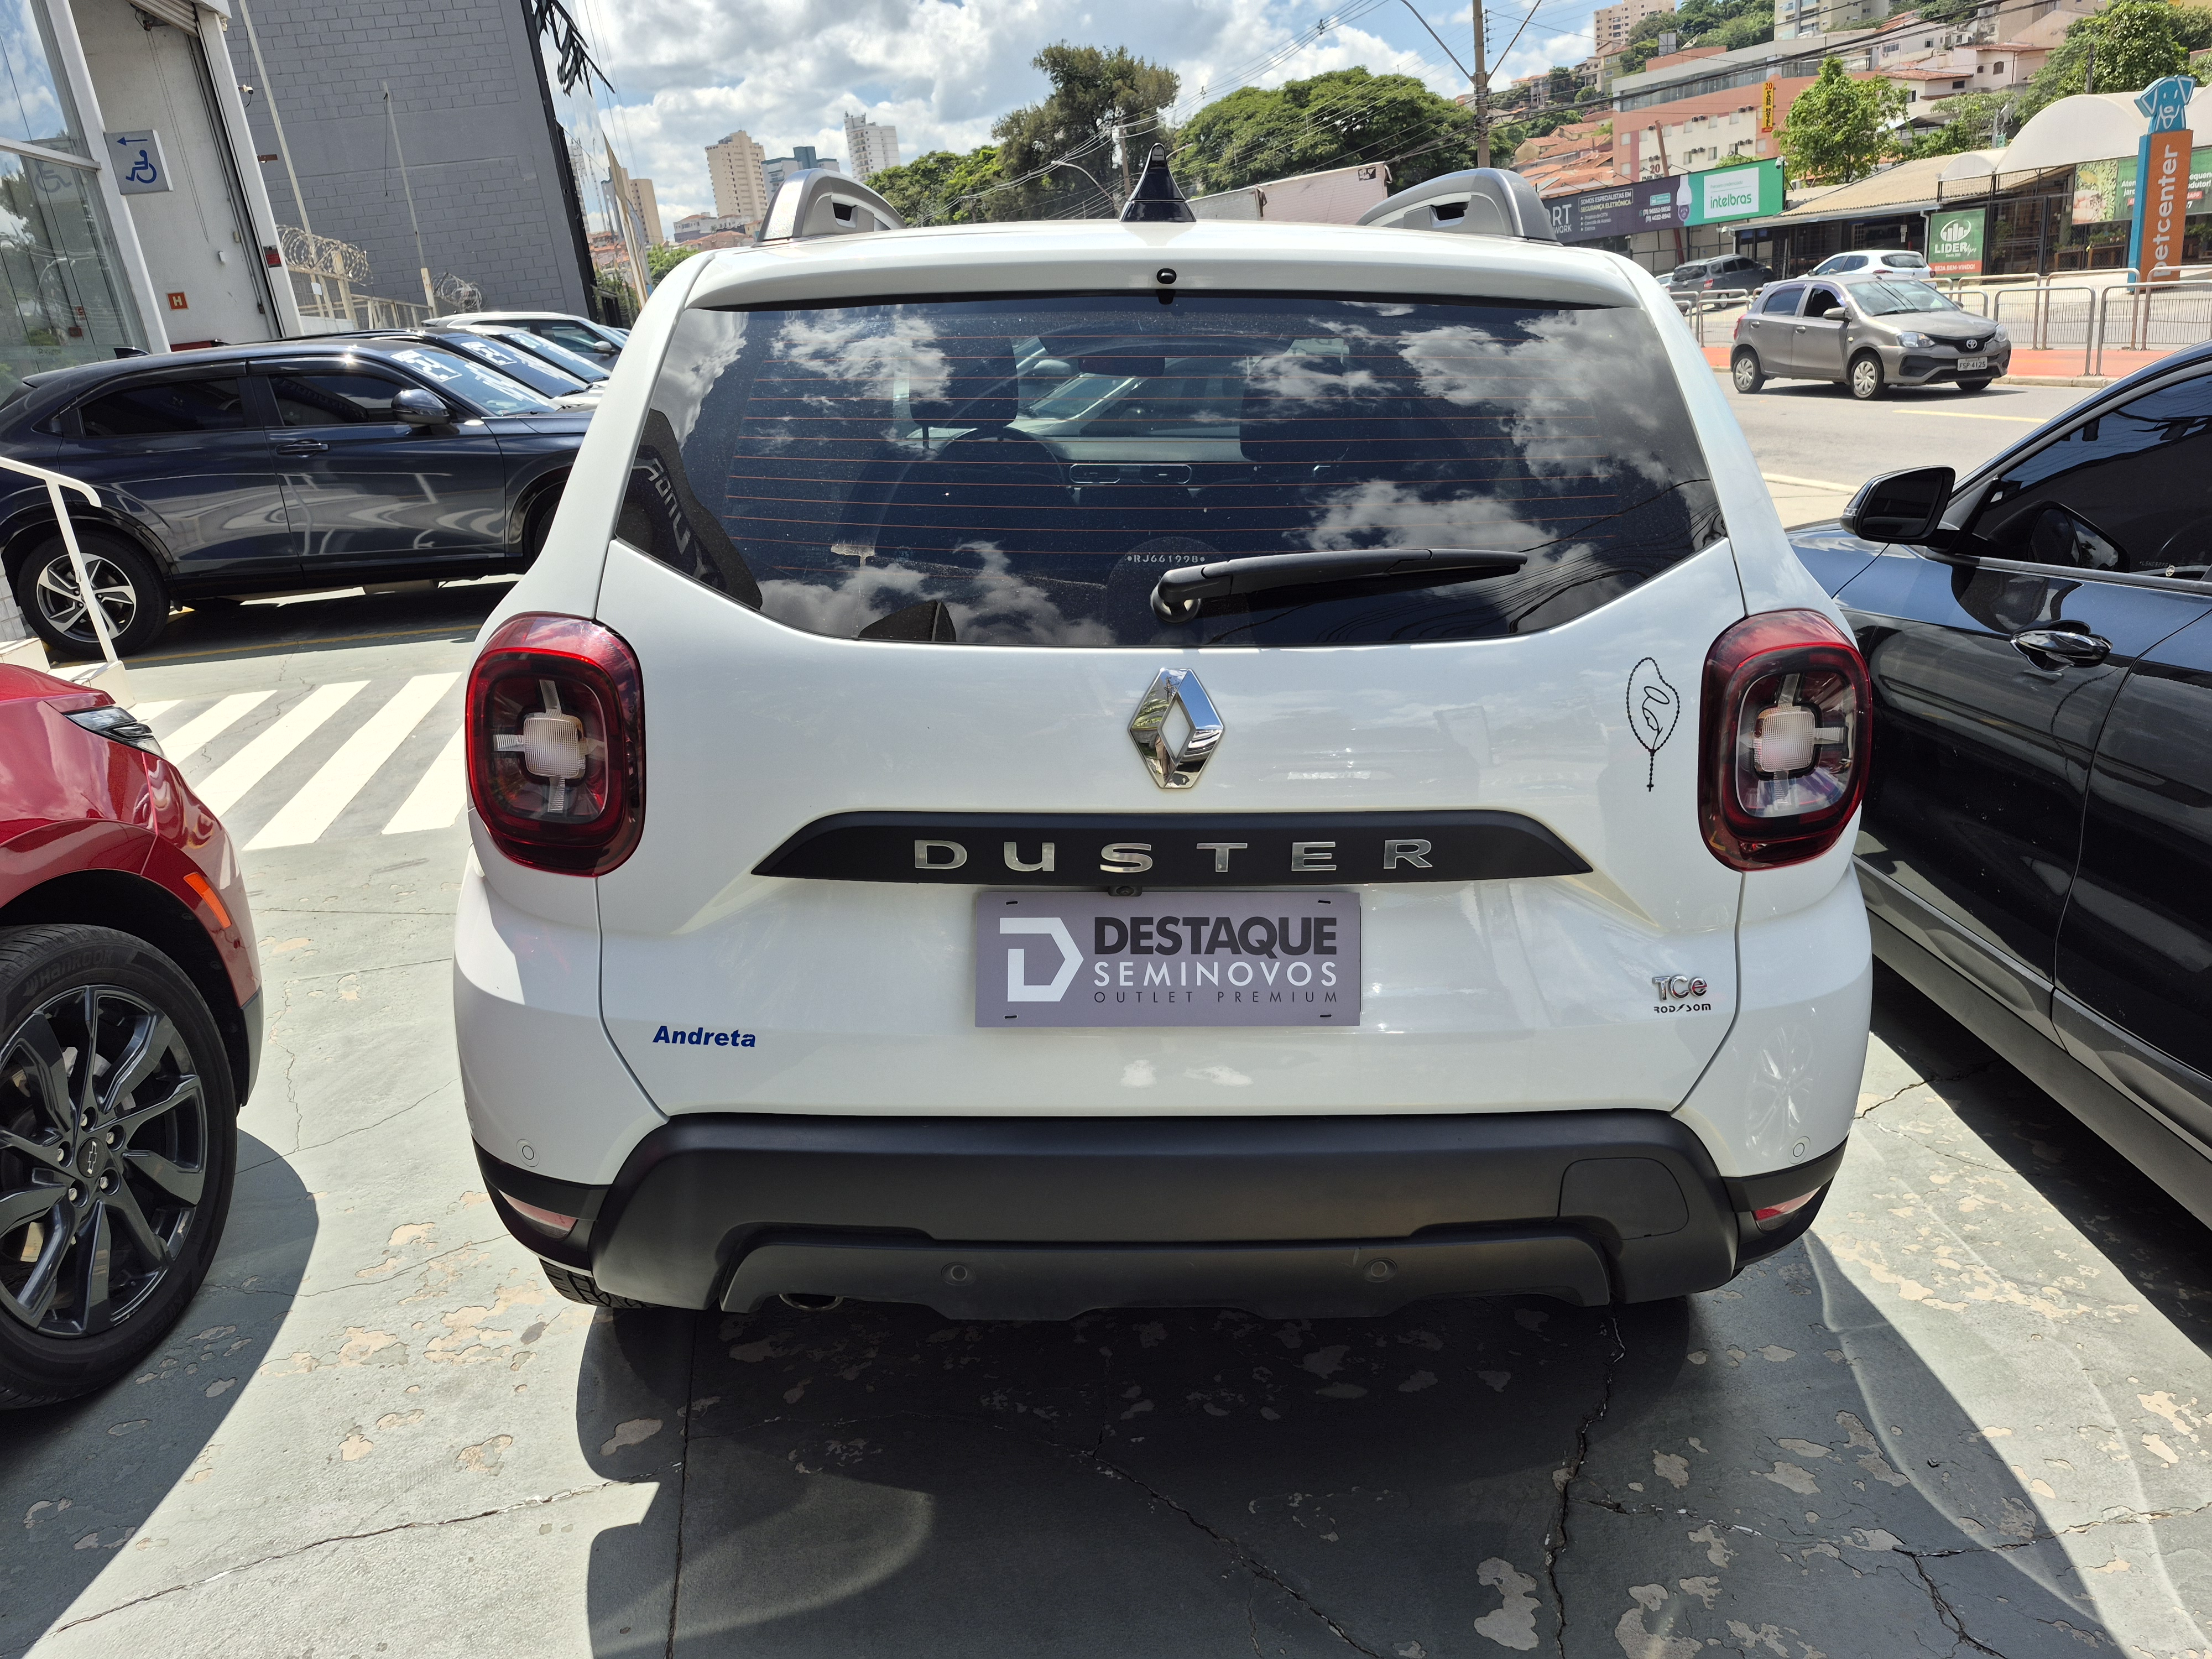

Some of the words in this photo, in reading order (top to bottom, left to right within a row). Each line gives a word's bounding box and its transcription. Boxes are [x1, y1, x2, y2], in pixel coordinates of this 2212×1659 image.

[1650, 164, 1661, 174] 20
[2189, 172, 2212, 181] equen
[1595, 192, 1625, 202] ESPECIALISTAS
[1710, 194, 1752, 209] intelbras
[1580, 203, 1605, 212] SEGURANÇA
[1605, 199, 1632, 208] ELETRÔNICA
[2152, 144, 2178, 277] petcenter
[1546, 204, 1572, 227] RT
[1934, 242, 1968, 254] LIDER
[172, 295, 183, 306] H
[914, 838, 1434, 873] DUSTER
[1094, 916, 1337, 959] DESTAQUE
[1093, 961, 1337, 987] SEMINOVOS
[1651, 974, 1708, 1001] TCe
[1094, 991, 1193, 1003] OUTLET
[1218, 991, 1337, 1003] PREMIUM
[652, 1025, 756, 1047] Andreta
